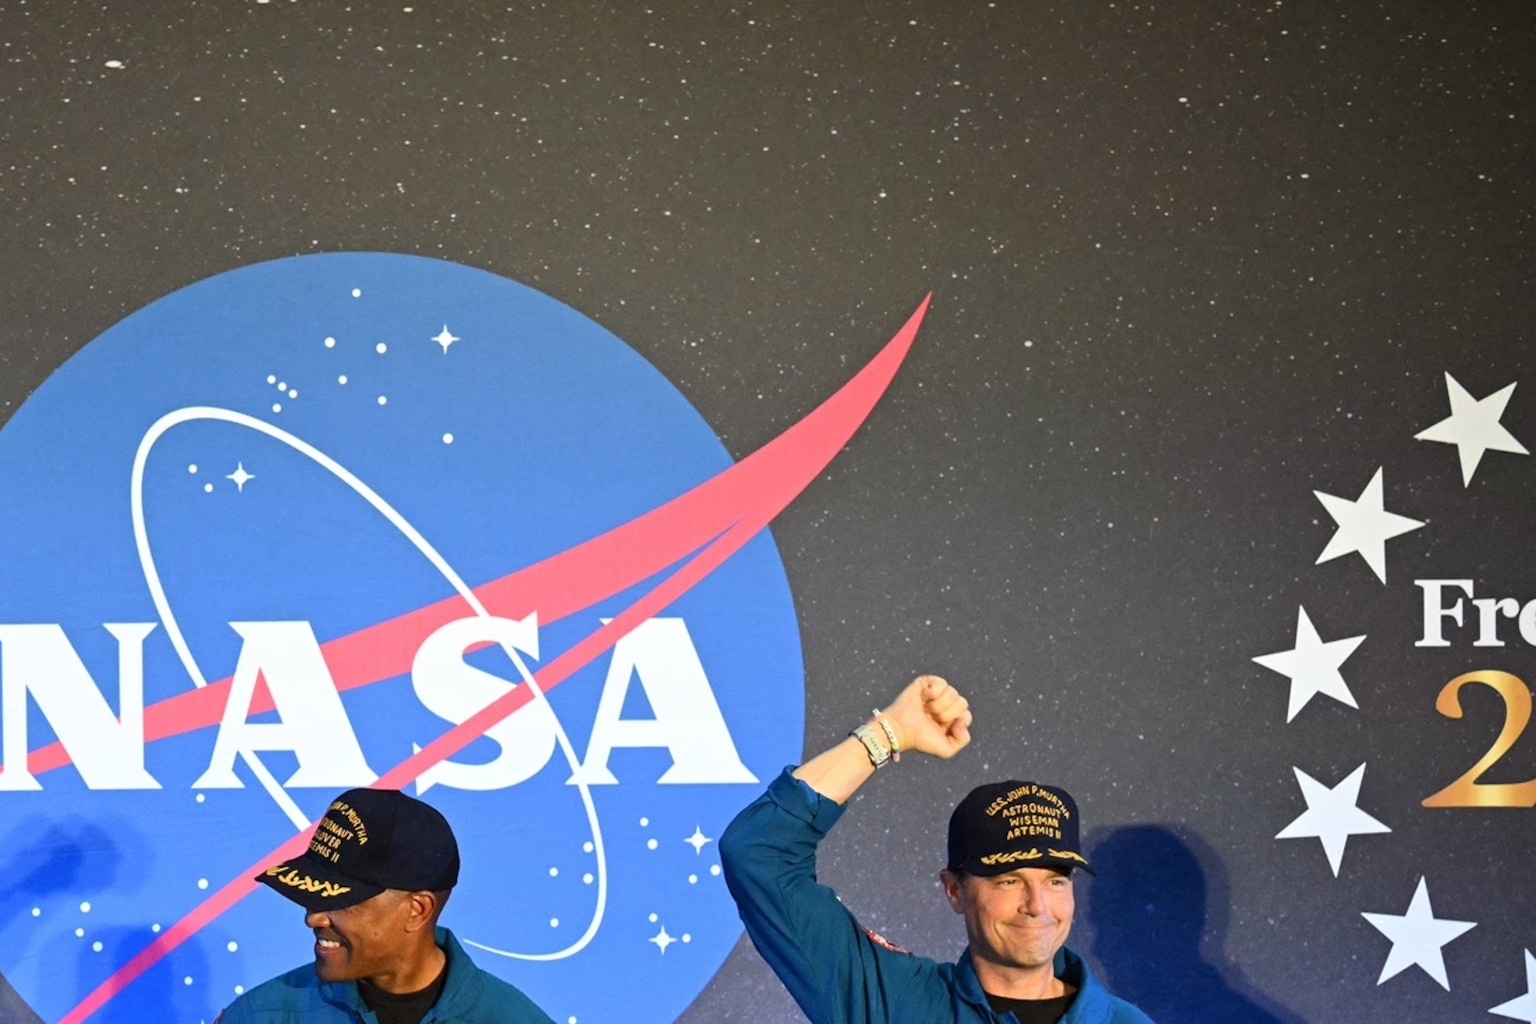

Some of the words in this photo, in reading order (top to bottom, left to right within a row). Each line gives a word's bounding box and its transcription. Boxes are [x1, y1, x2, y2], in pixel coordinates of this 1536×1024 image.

[1007, 786, 1030, 802] JOHN
[1003, 803, 1061, 819] ASTRONAUT
[1009, 815, 1060, 828] WISEMAN
[1007, 826, 1055, 841] ARTEMIS
[331, 852, 340, 863] II
